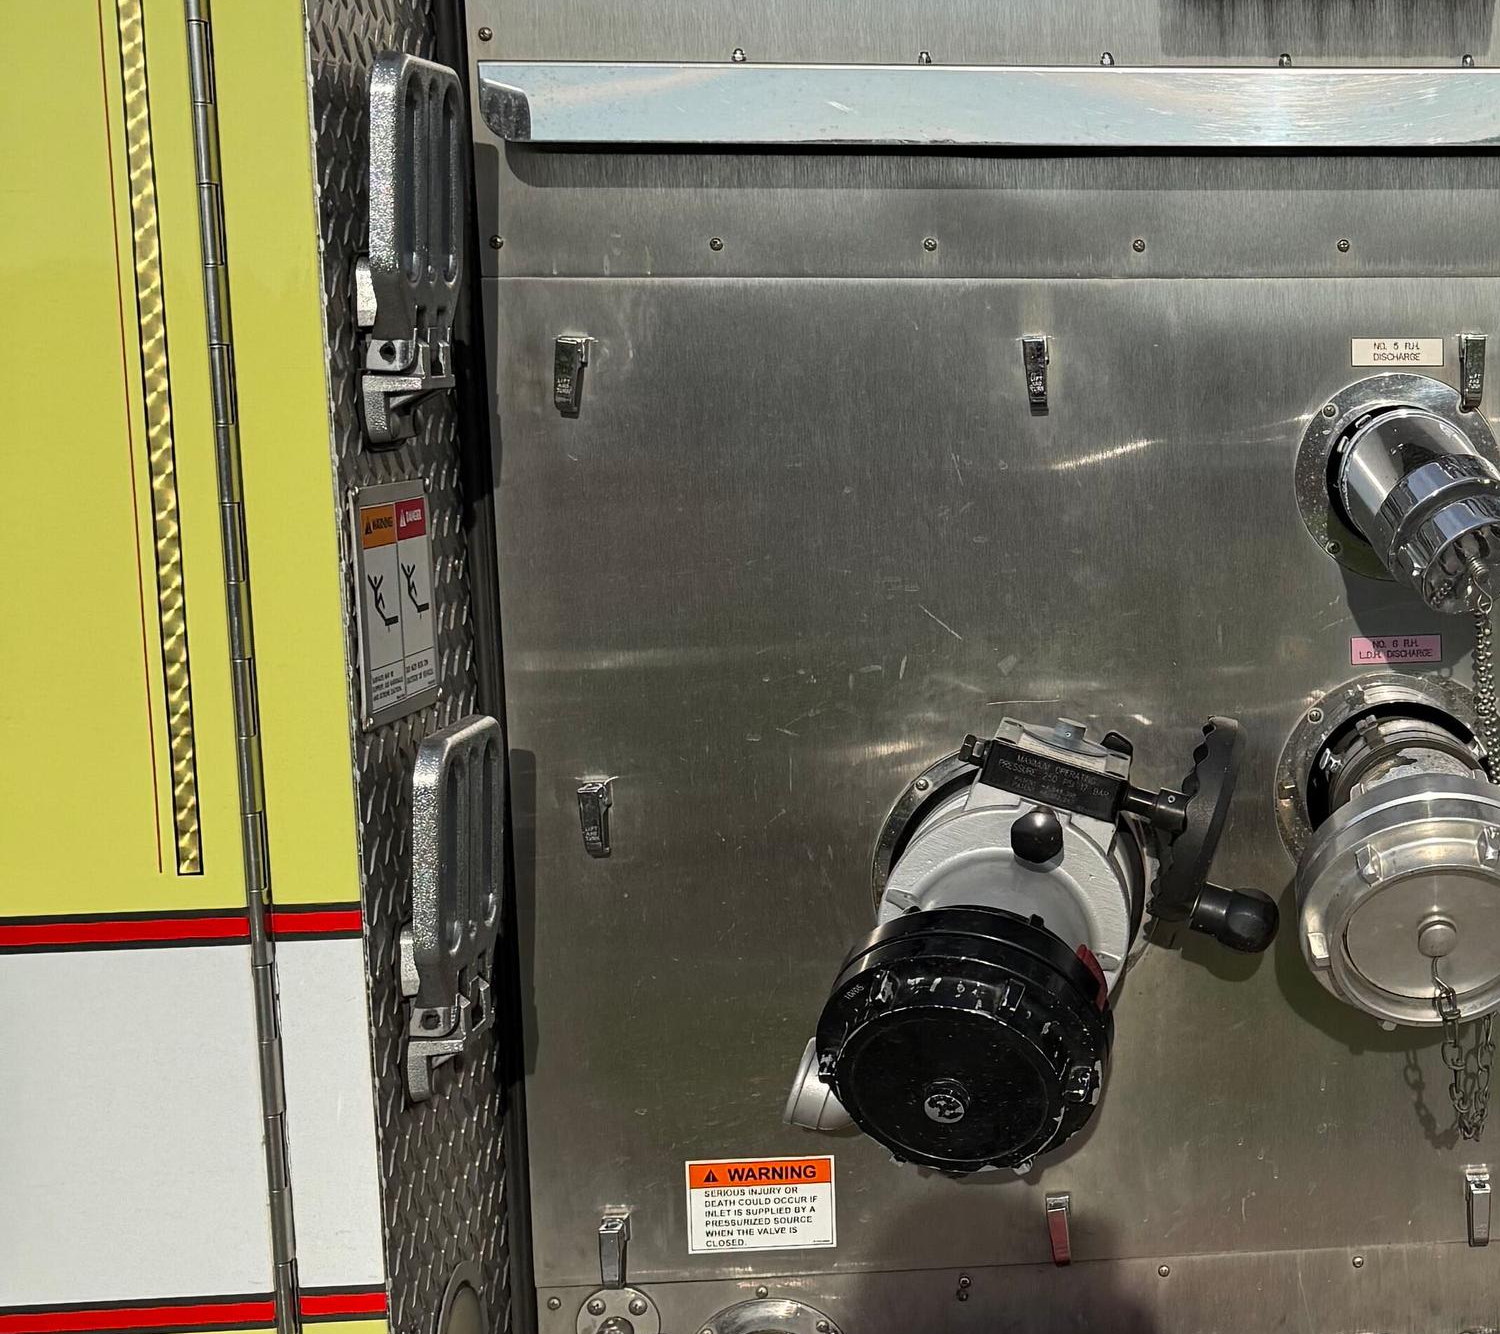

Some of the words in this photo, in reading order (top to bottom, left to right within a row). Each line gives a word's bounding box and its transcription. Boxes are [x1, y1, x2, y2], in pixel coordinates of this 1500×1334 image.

[1373, 342, 1387, 351] NO.
[1373, 352, 1421, 361] DISCHARGE
[1372, 640, 1387, 649] NO.
[1386, 649, 1433, 659] DISCHARGE
[998, 758, 1037, 778] PRESSURE
[1055, 766, 1097, 785] OPERATING
[727, 1164, 817, 1182] WARNING
[704, 1189, 746, 1198] SERIOUS
[748, 1187, 782, 1196] INJURY
[784, 1186, 798, 1195] OR
[704, 1198, 736, 1208] DEATH
[738, 1197, 771, 1206] COULD
[773, 1196, 807, 1205] OCCUR
[809, 1195, 818, 1204] IF
[705, 1208, 731, 1218] INLET
[734, 1208, 743, 1216] IS
[745, 1206, 792, 1216] SUPPLIED
[794, 1206, 807, 1214] BY
[809, 1205, 816, 1213] A
[705, 1217, 771, 1228] PRESSURIZED
[773, 1215, 813, 1225] SOURCE
[705, 1228, 734, 1238] WHEN
[736, 1227, 755, 1236] THE
[757, 1226, 787, 1235] VALVE
[789, 1226, 798, 1234] IS
[706, 1238, 747, 1248] CLOSED.
